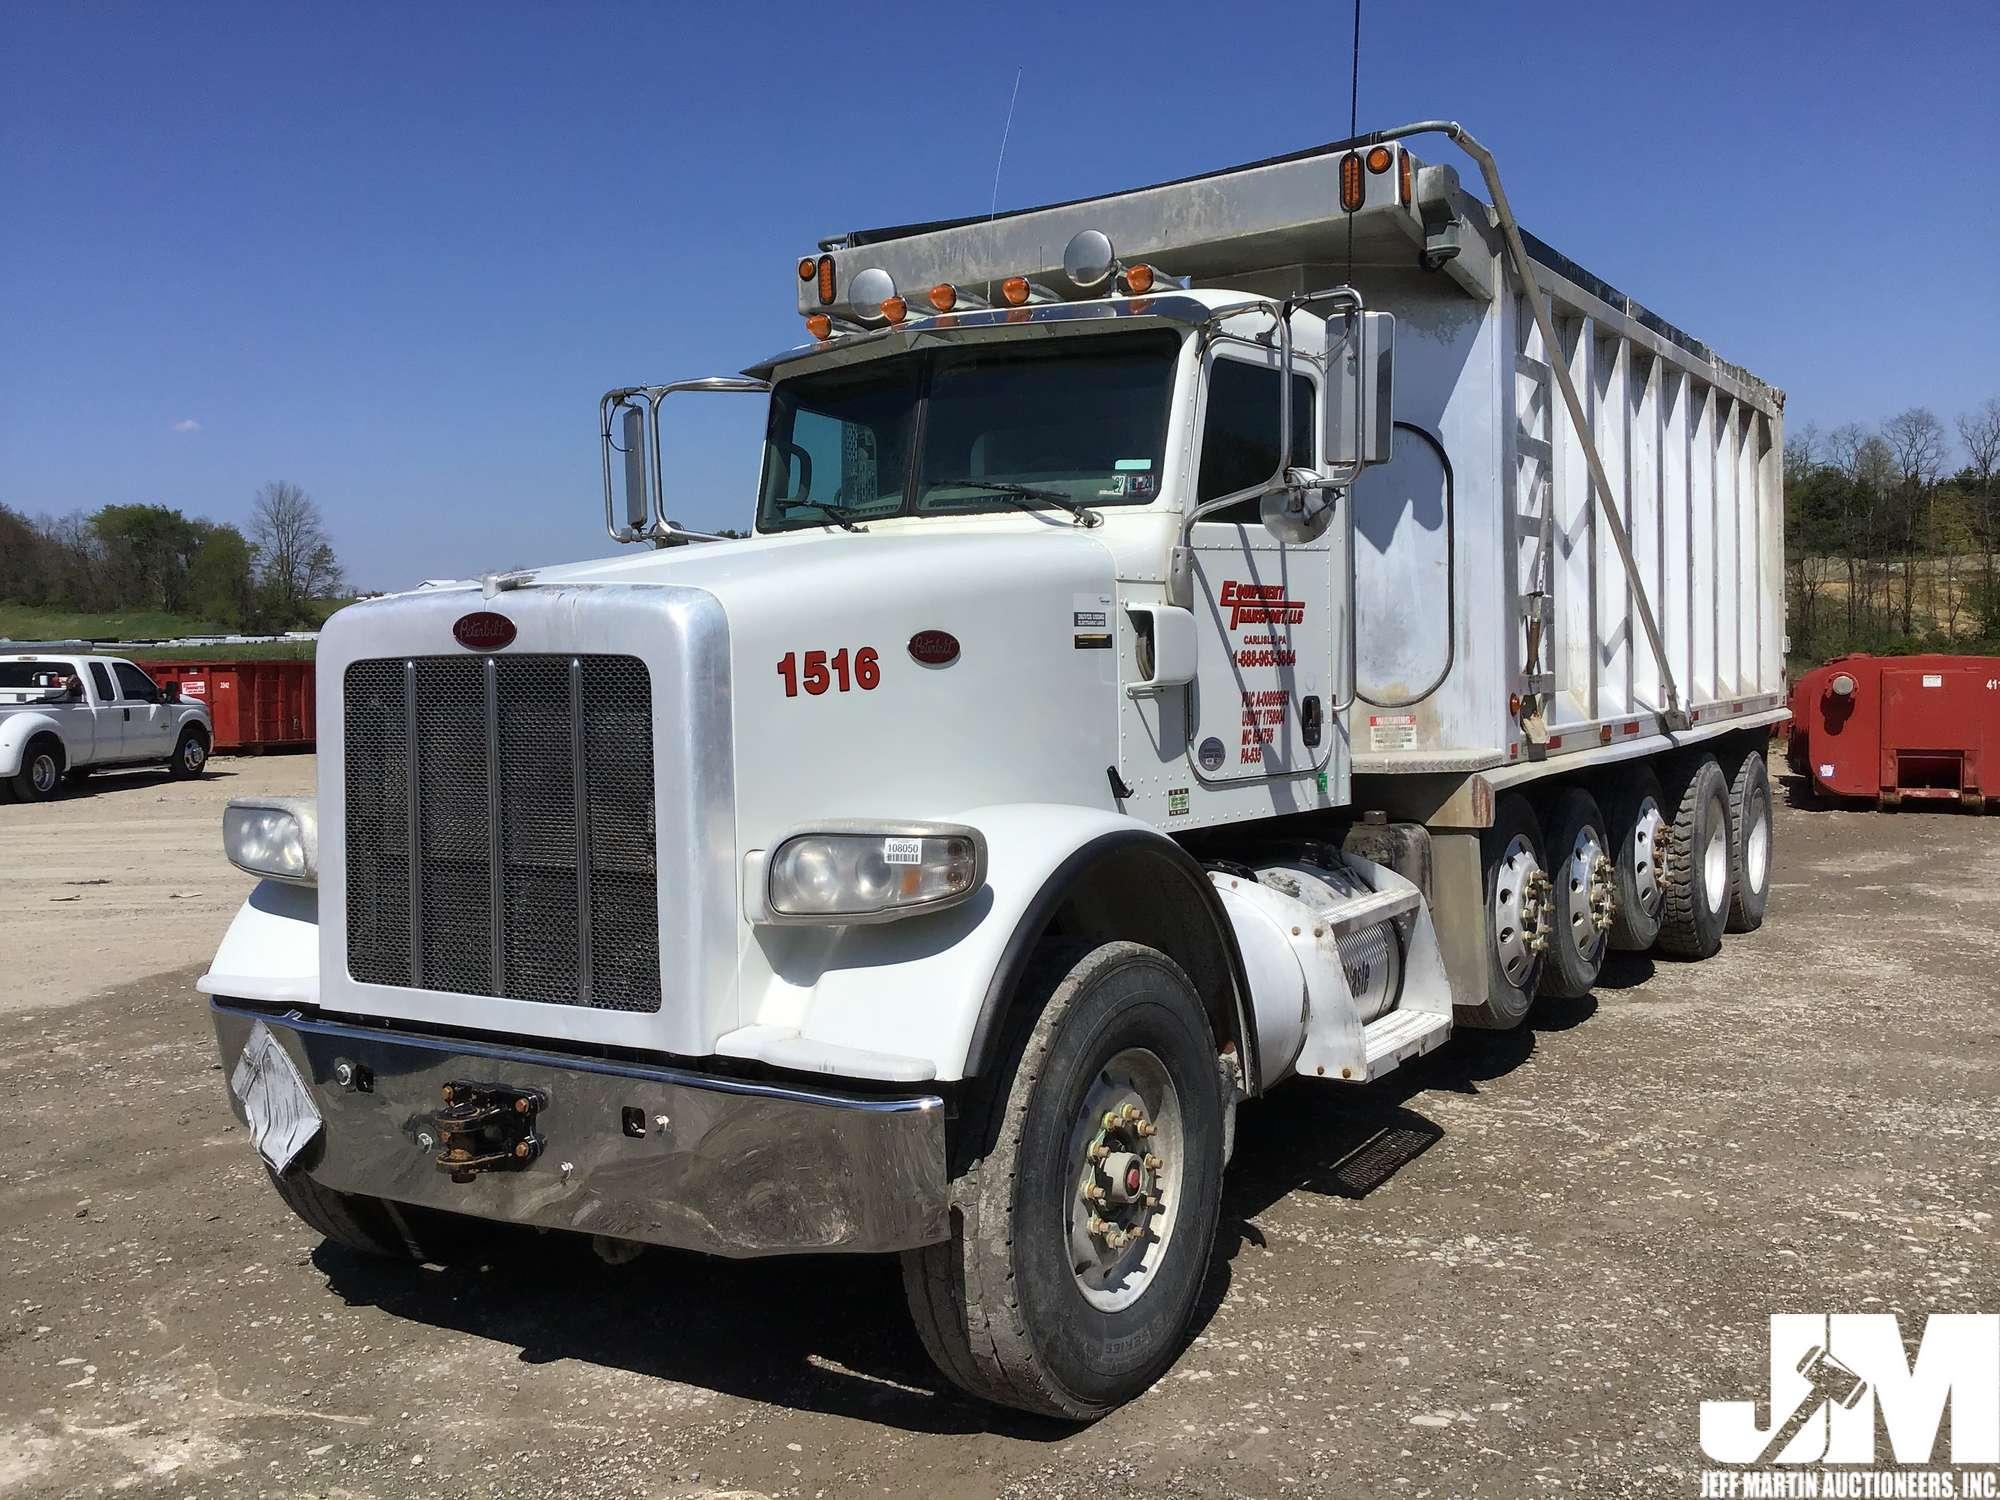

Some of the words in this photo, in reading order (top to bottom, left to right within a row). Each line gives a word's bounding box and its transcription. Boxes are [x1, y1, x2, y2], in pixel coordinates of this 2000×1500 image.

[1279, 636, 1287, 645] PA
[776, 646, 880, 697] 1516
[1242, 729, 1252, 745] MC
[888, 843, 919, 853] 108050
